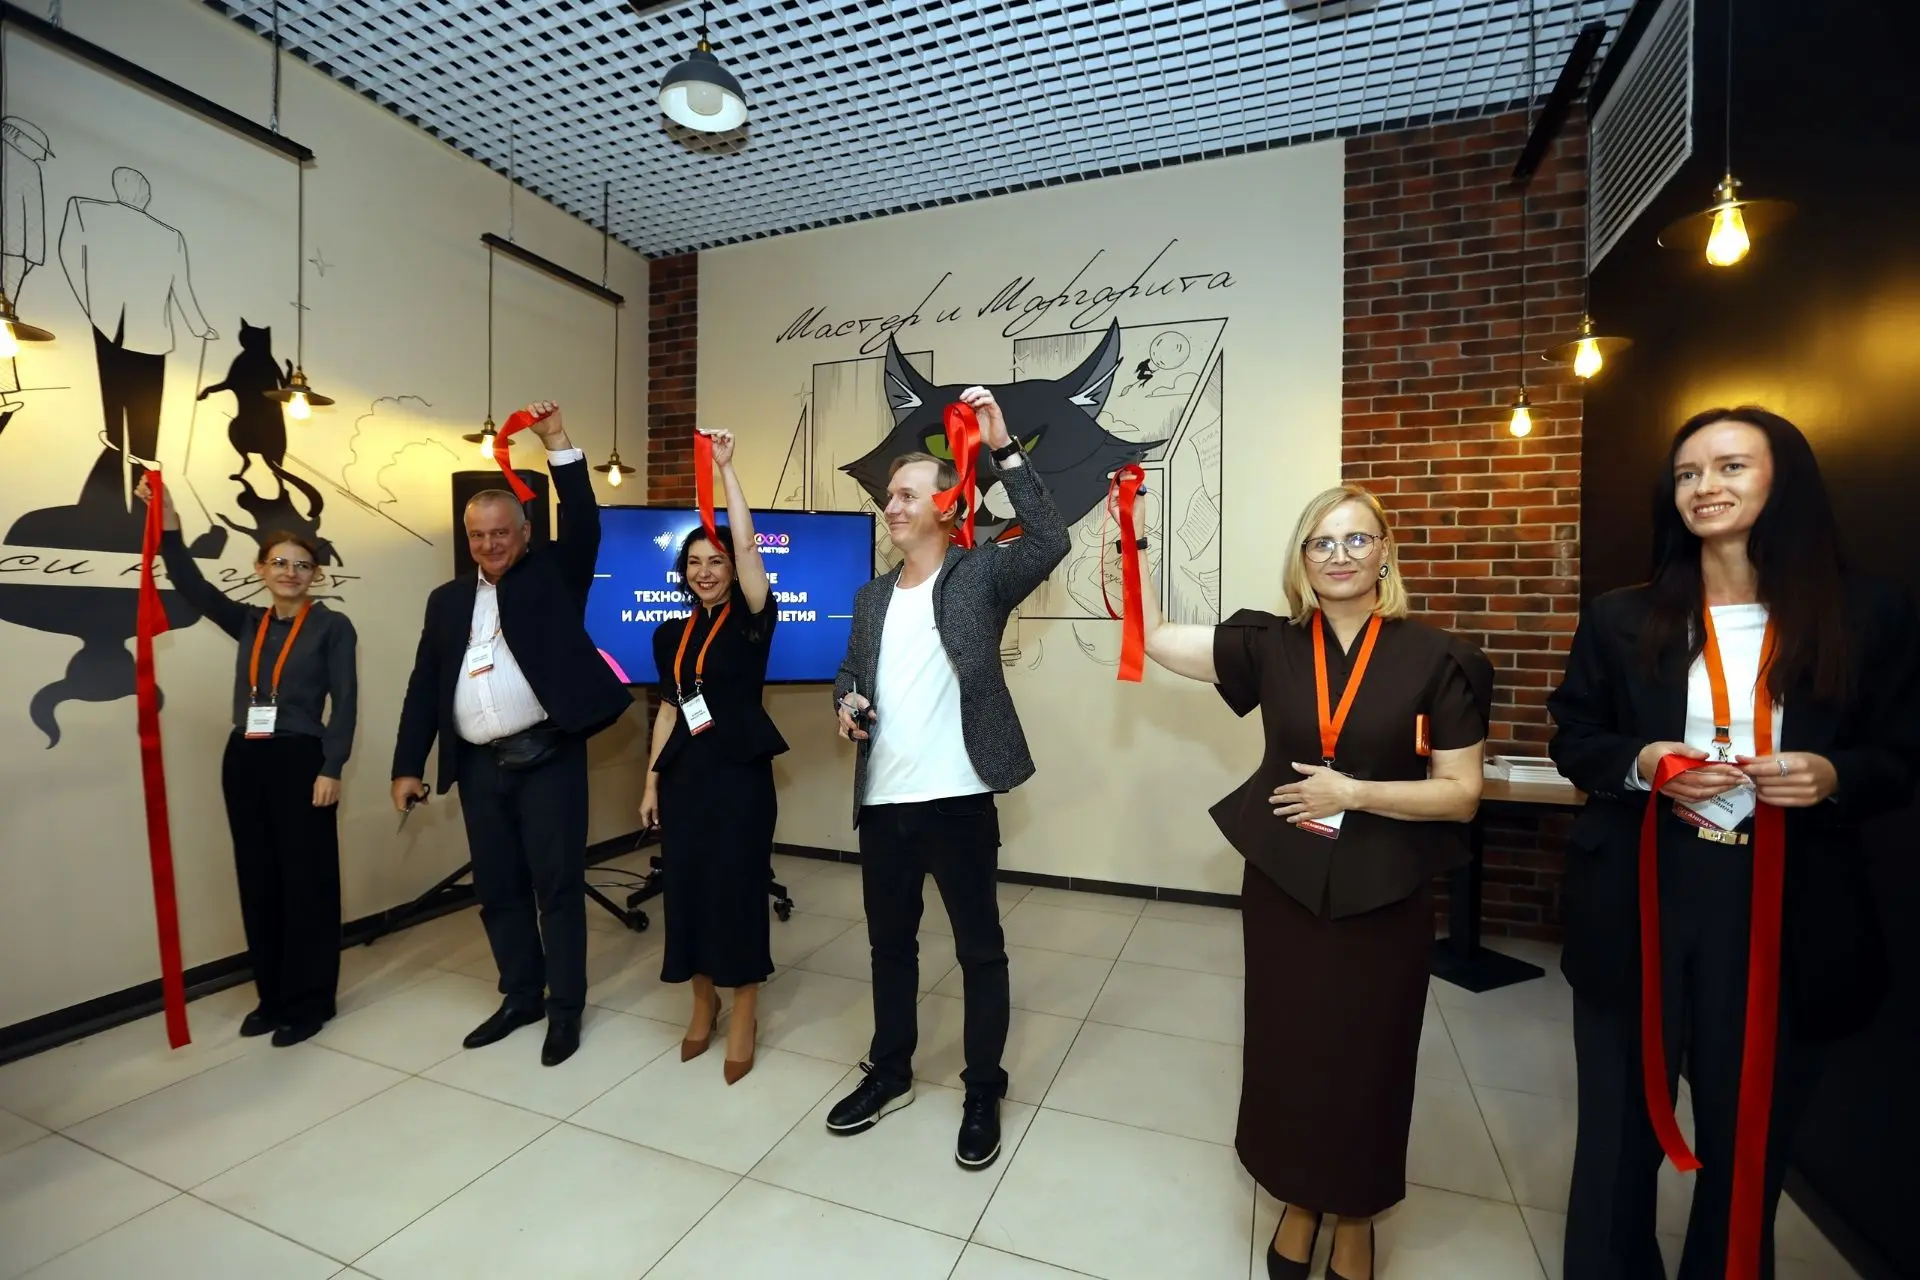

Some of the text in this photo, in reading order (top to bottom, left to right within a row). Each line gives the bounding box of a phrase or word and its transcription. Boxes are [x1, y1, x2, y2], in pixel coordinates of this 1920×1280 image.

[776, 271, 952, 354] Мастер
[978, 238, 1237, 338] Маргарита
[634, 591, 692, 603] ТЕХНО
[622, 610, 632, 622] И
